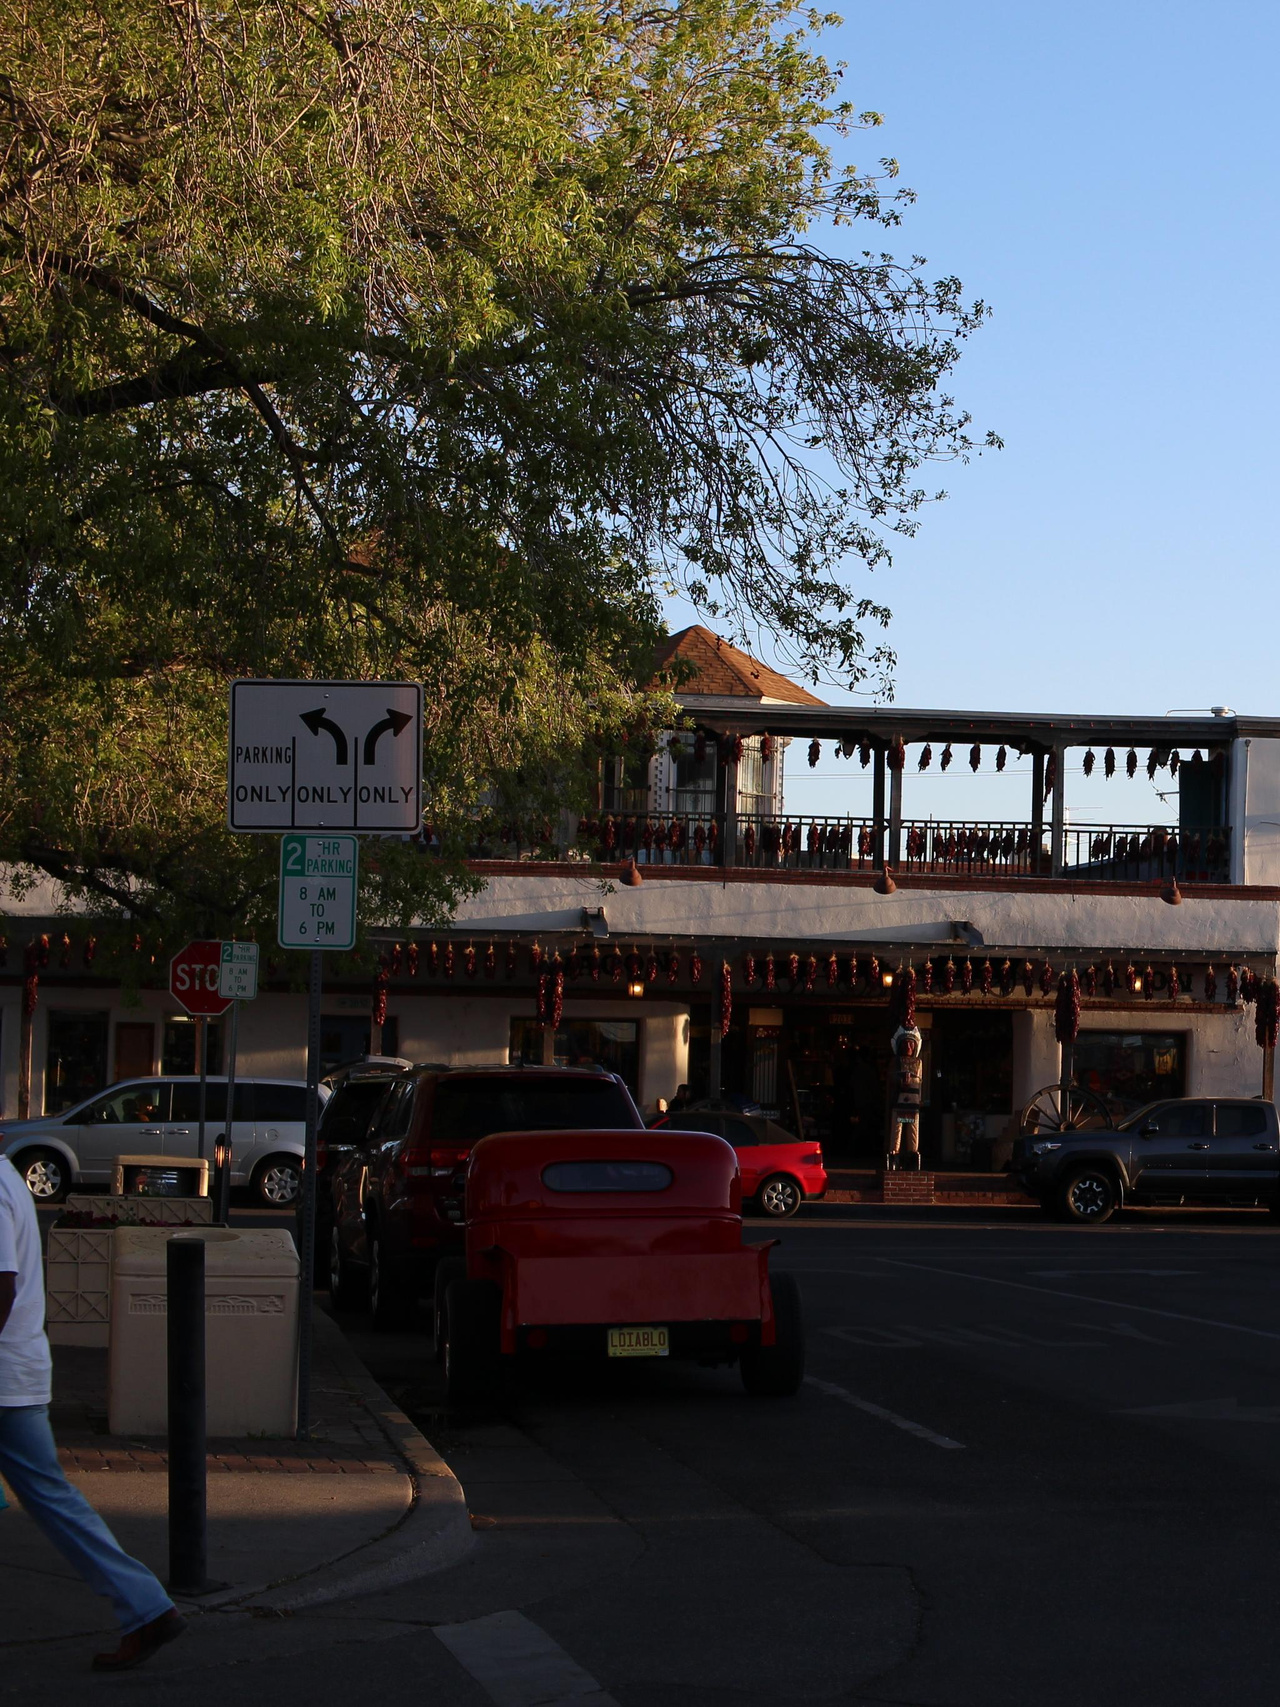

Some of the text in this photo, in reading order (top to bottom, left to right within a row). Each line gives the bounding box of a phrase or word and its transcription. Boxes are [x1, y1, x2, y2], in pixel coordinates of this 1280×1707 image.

[236, 746, 292, 764] PARKING
[235, 785, 413, 803] ONLY ONLY ONLY
[286, 841, 341, 870] 2 HR
[306, 858, 353, 874] PARKING
[299, 886, 336, 901] 8 AM
[309, 903, 325, 918] TO
[299, 921, 335, 935] 6 PM
[223, 945, 232, 960] 2
[175, 963, 220, 992] STO
[228, 967, 248, 976] 8 AM
[234, 975, 242, 983] TO
[610, 1331, 666, 1347] LDIABLO
